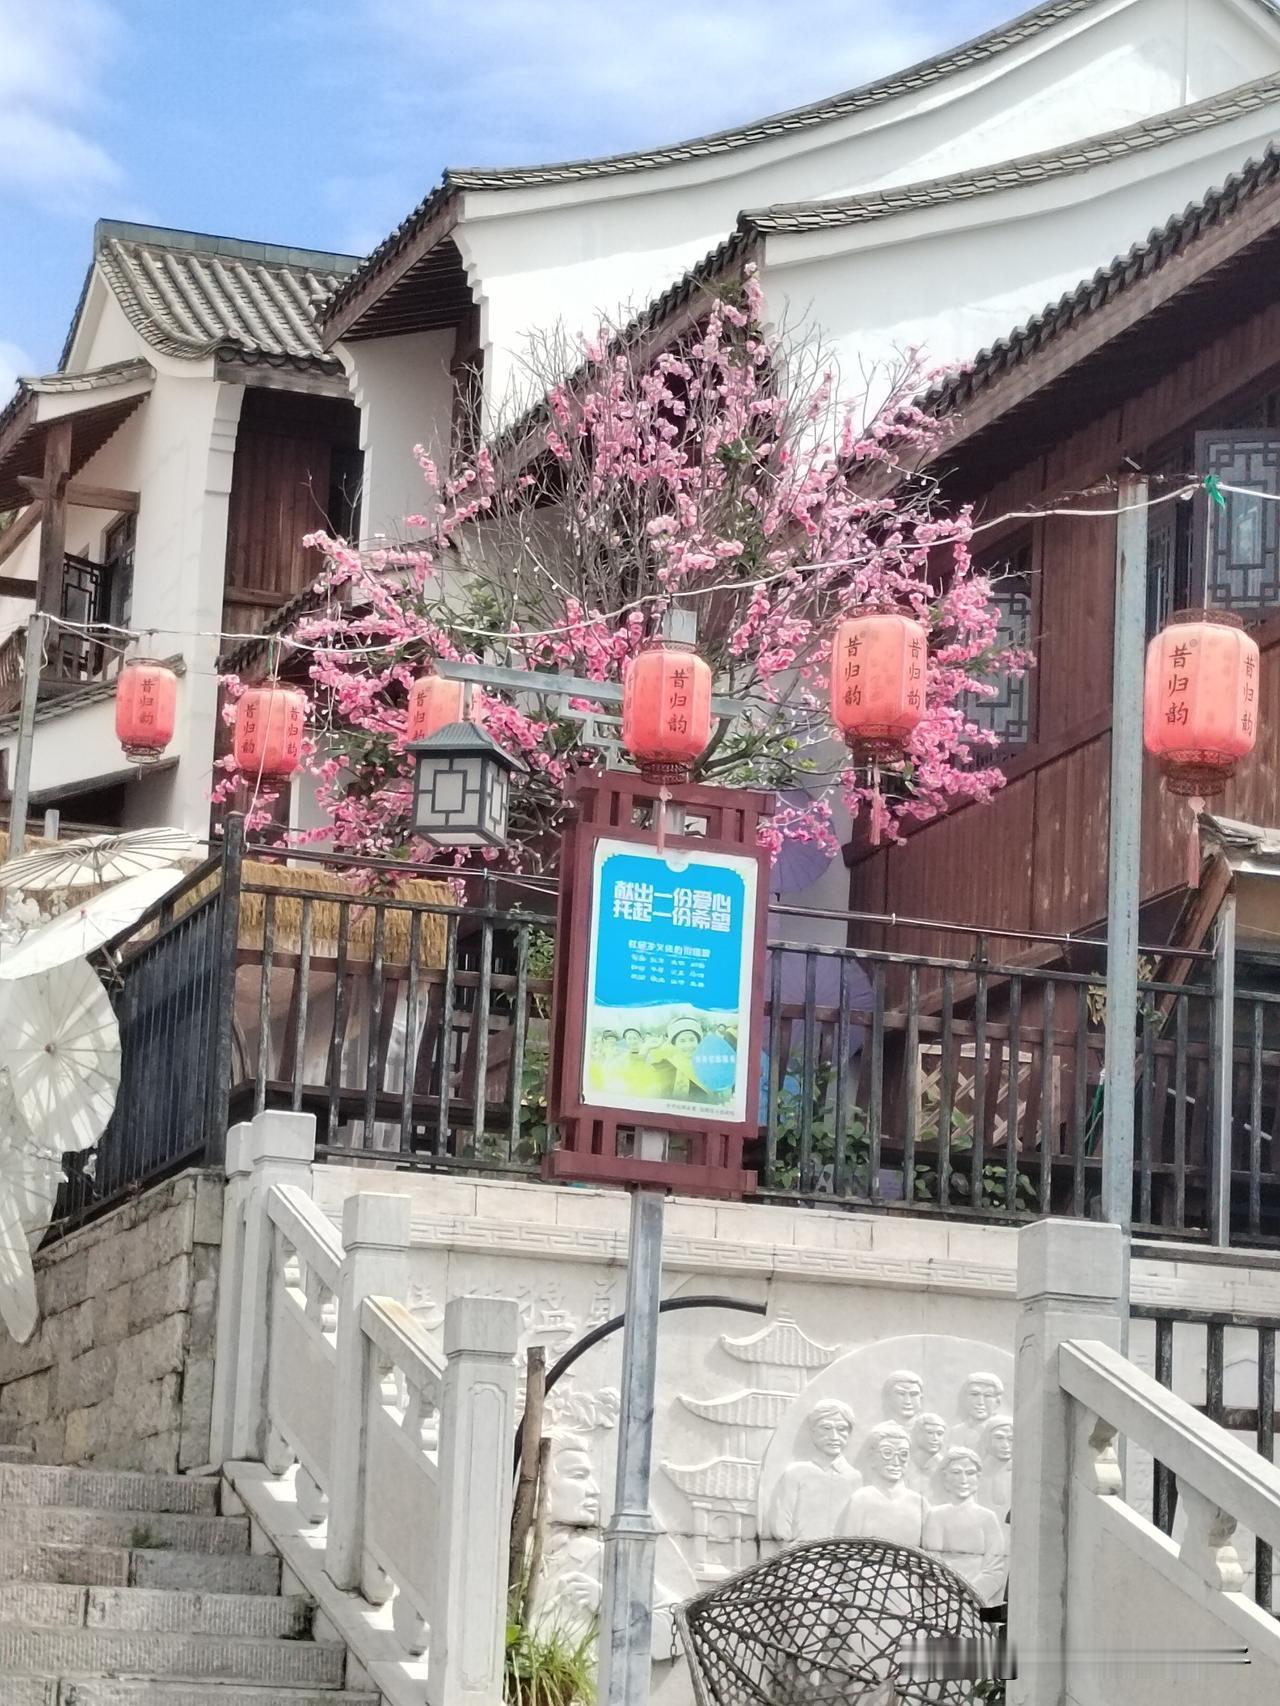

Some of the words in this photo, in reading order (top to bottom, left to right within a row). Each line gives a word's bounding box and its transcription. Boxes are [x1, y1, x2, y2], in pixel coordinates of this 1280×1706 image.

[841, 635, 862, 706] 昔归韵
[907, 638, 922, 710] 昔归韵
[1165, 643, 1192, 725] 昔归韵
[139, 678, 156, 725] 昔归韵
[241, 704, 257, 754] 昔归韵
[668, 669, 689, 735] 昔归韵
[613, 900, 730, 932] 托起一份希望
[615, 880, 731, 912] 献出一份爱心
